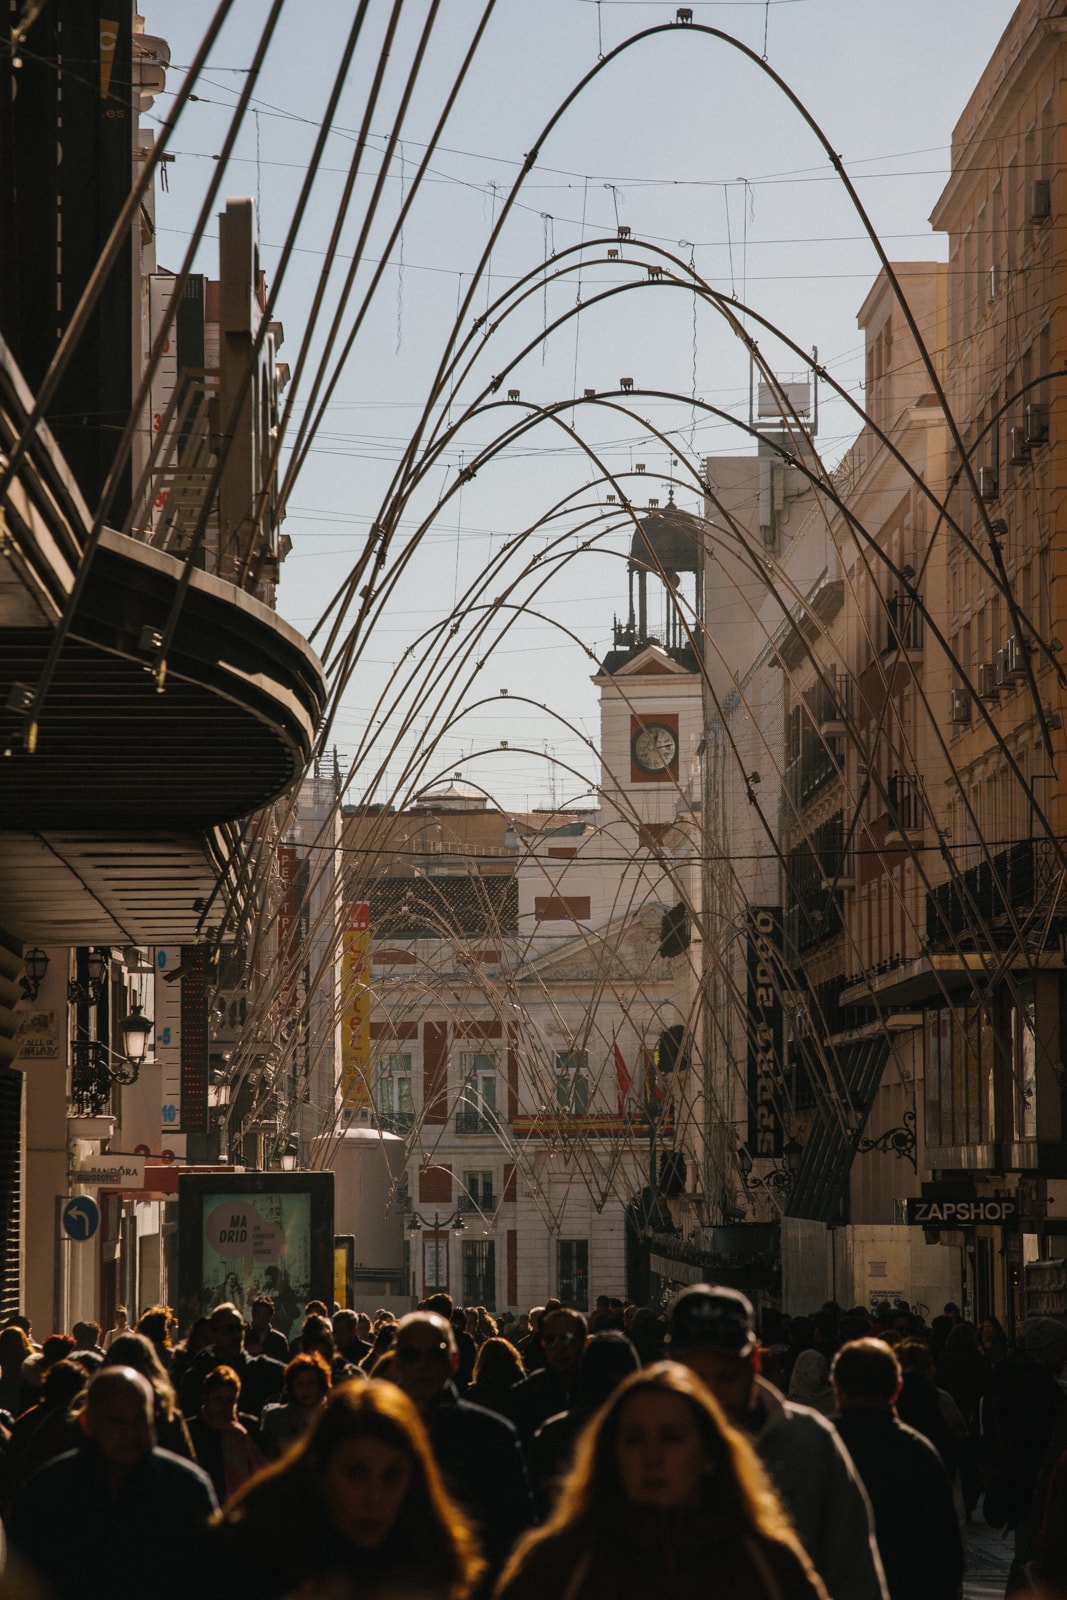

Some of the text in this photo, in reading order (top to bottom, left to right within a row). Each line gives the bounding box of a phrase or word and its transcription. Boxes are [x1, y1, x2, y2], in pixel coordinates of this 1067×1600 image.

[157, 1027, 171, 1045] -5
[914, 1201, 1016, 1221] ZAPSHOP
[229, 1215, 247, 1229] MA
[219, 1229, 248, 1243] DRID
